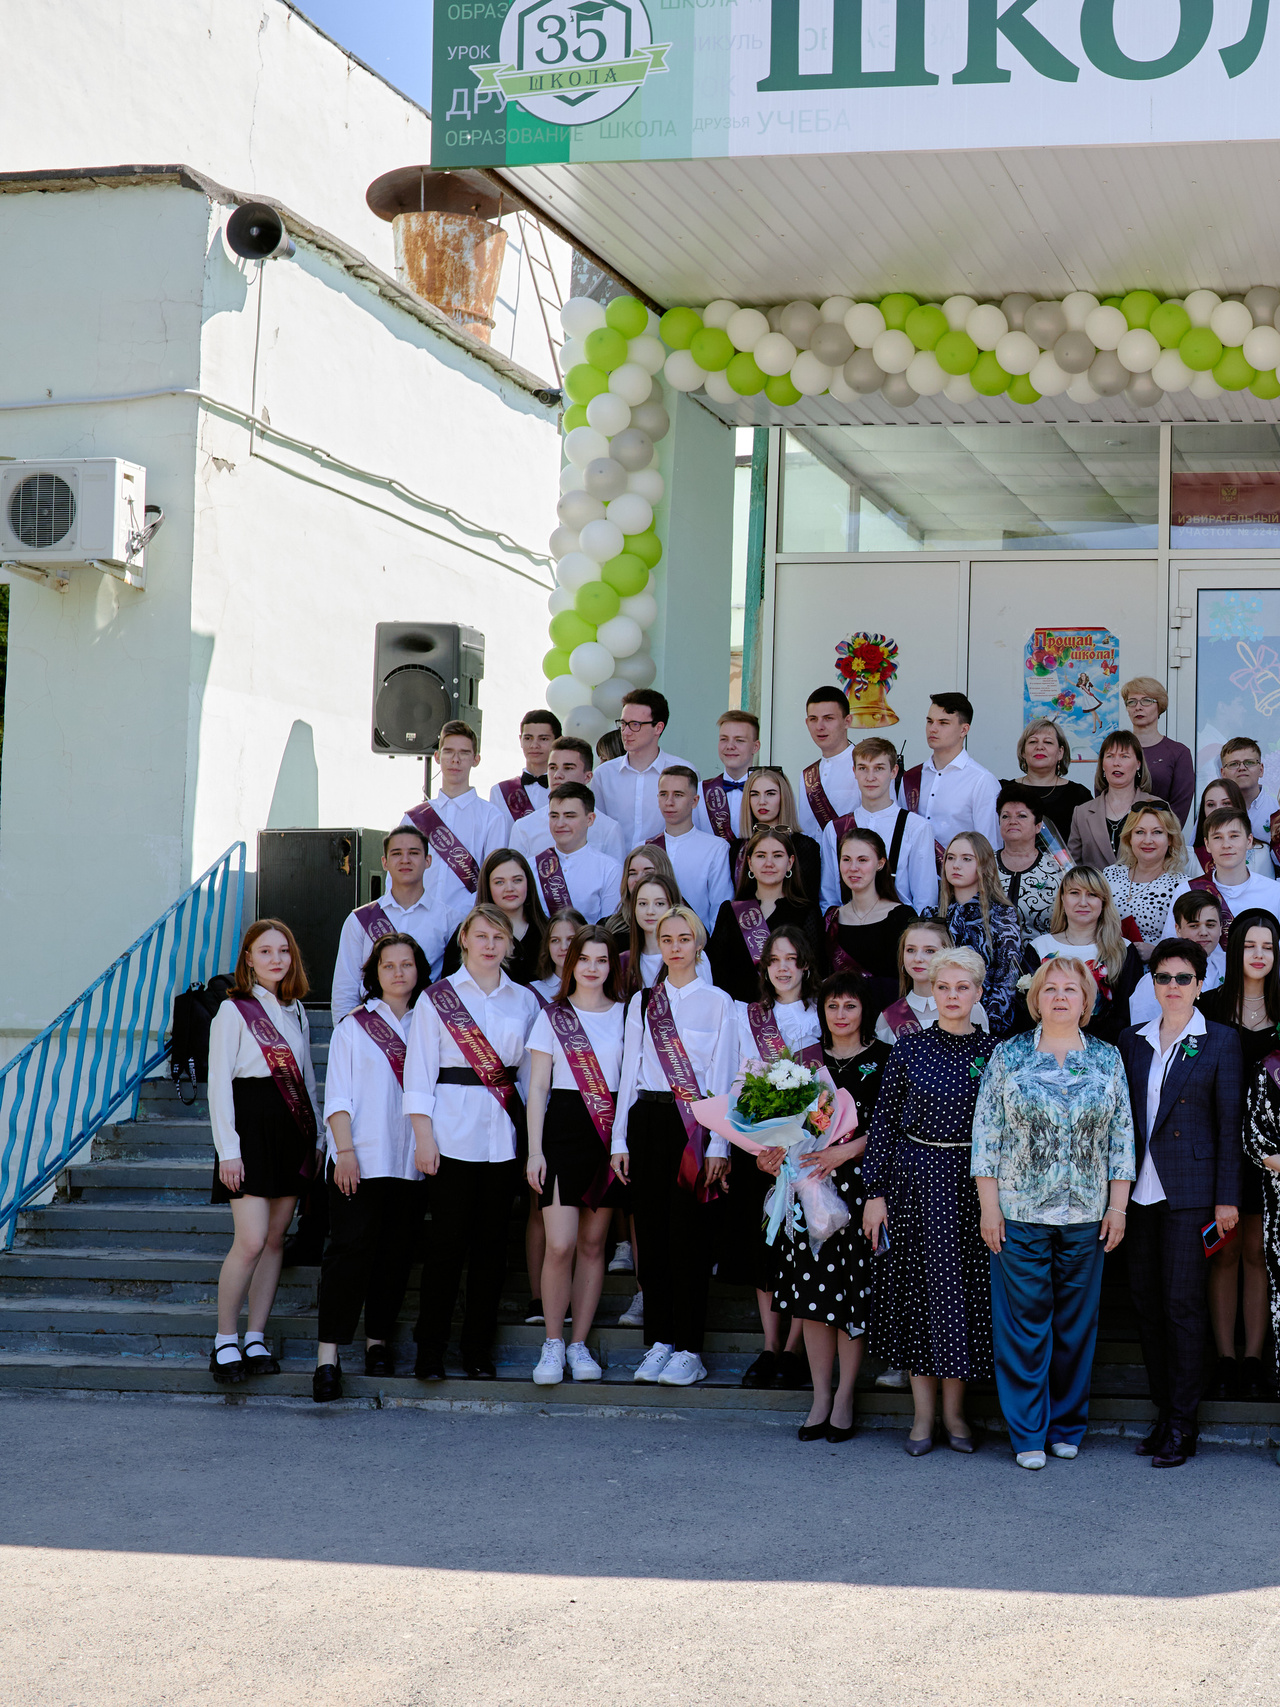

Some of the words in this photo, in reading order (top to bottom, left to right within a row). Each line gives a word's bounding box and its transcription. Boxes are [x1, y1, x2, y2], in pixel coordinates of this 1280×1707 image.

[534, 9, 608, 65] 35
[447, 44, 491, 61] УРОК
[528, 67, 618, 91] ШКОЛА
[445, 126, 584, 147] ОБРАЗОВАНИЕ
[600, 119, 678, 140] ШКОЛА
[693, 116, 751, 132] ДРУЗЬЯ
[756, 108, 852, 136] УЧЕБА
[1178, 513, 1280, 524] ИЗБИРАТЕЛЬНЫЙ
[1178, 527, 1232, 537] УЧАСТОК
[1237, 527, 1250, 537] №
[1033, 631, 1096, 649] Прощай,
[1070, 648, 1115, 660] школа!
